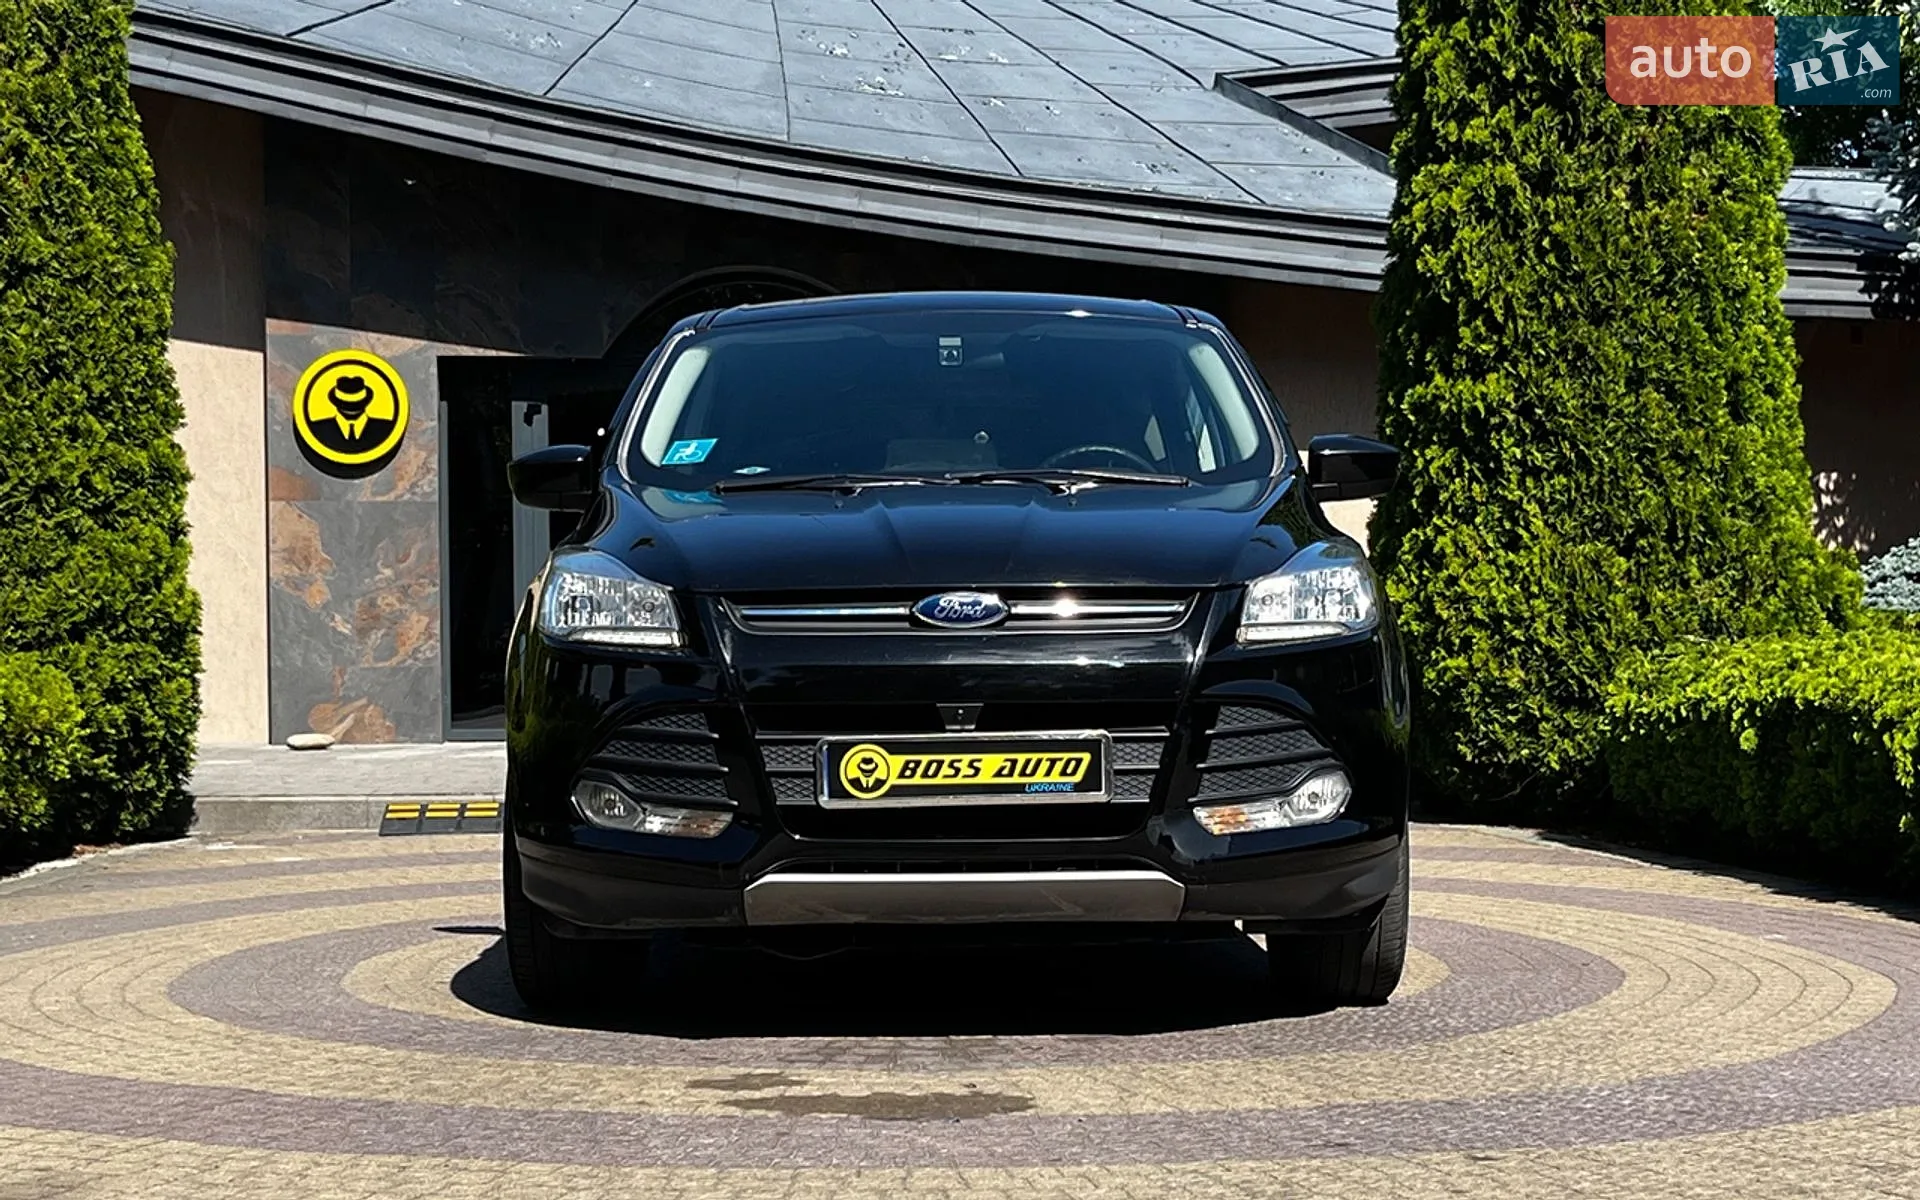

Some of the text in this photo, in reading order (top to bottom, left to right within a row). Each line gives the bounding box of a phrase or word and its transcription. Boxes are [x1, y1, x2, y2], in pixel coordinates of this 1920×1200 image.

[934, 596, 986, 619] Ford
[896, 756, 1084, 780] BOSS AUTO
[1024, 782, 1075, 793] UKRAINE
